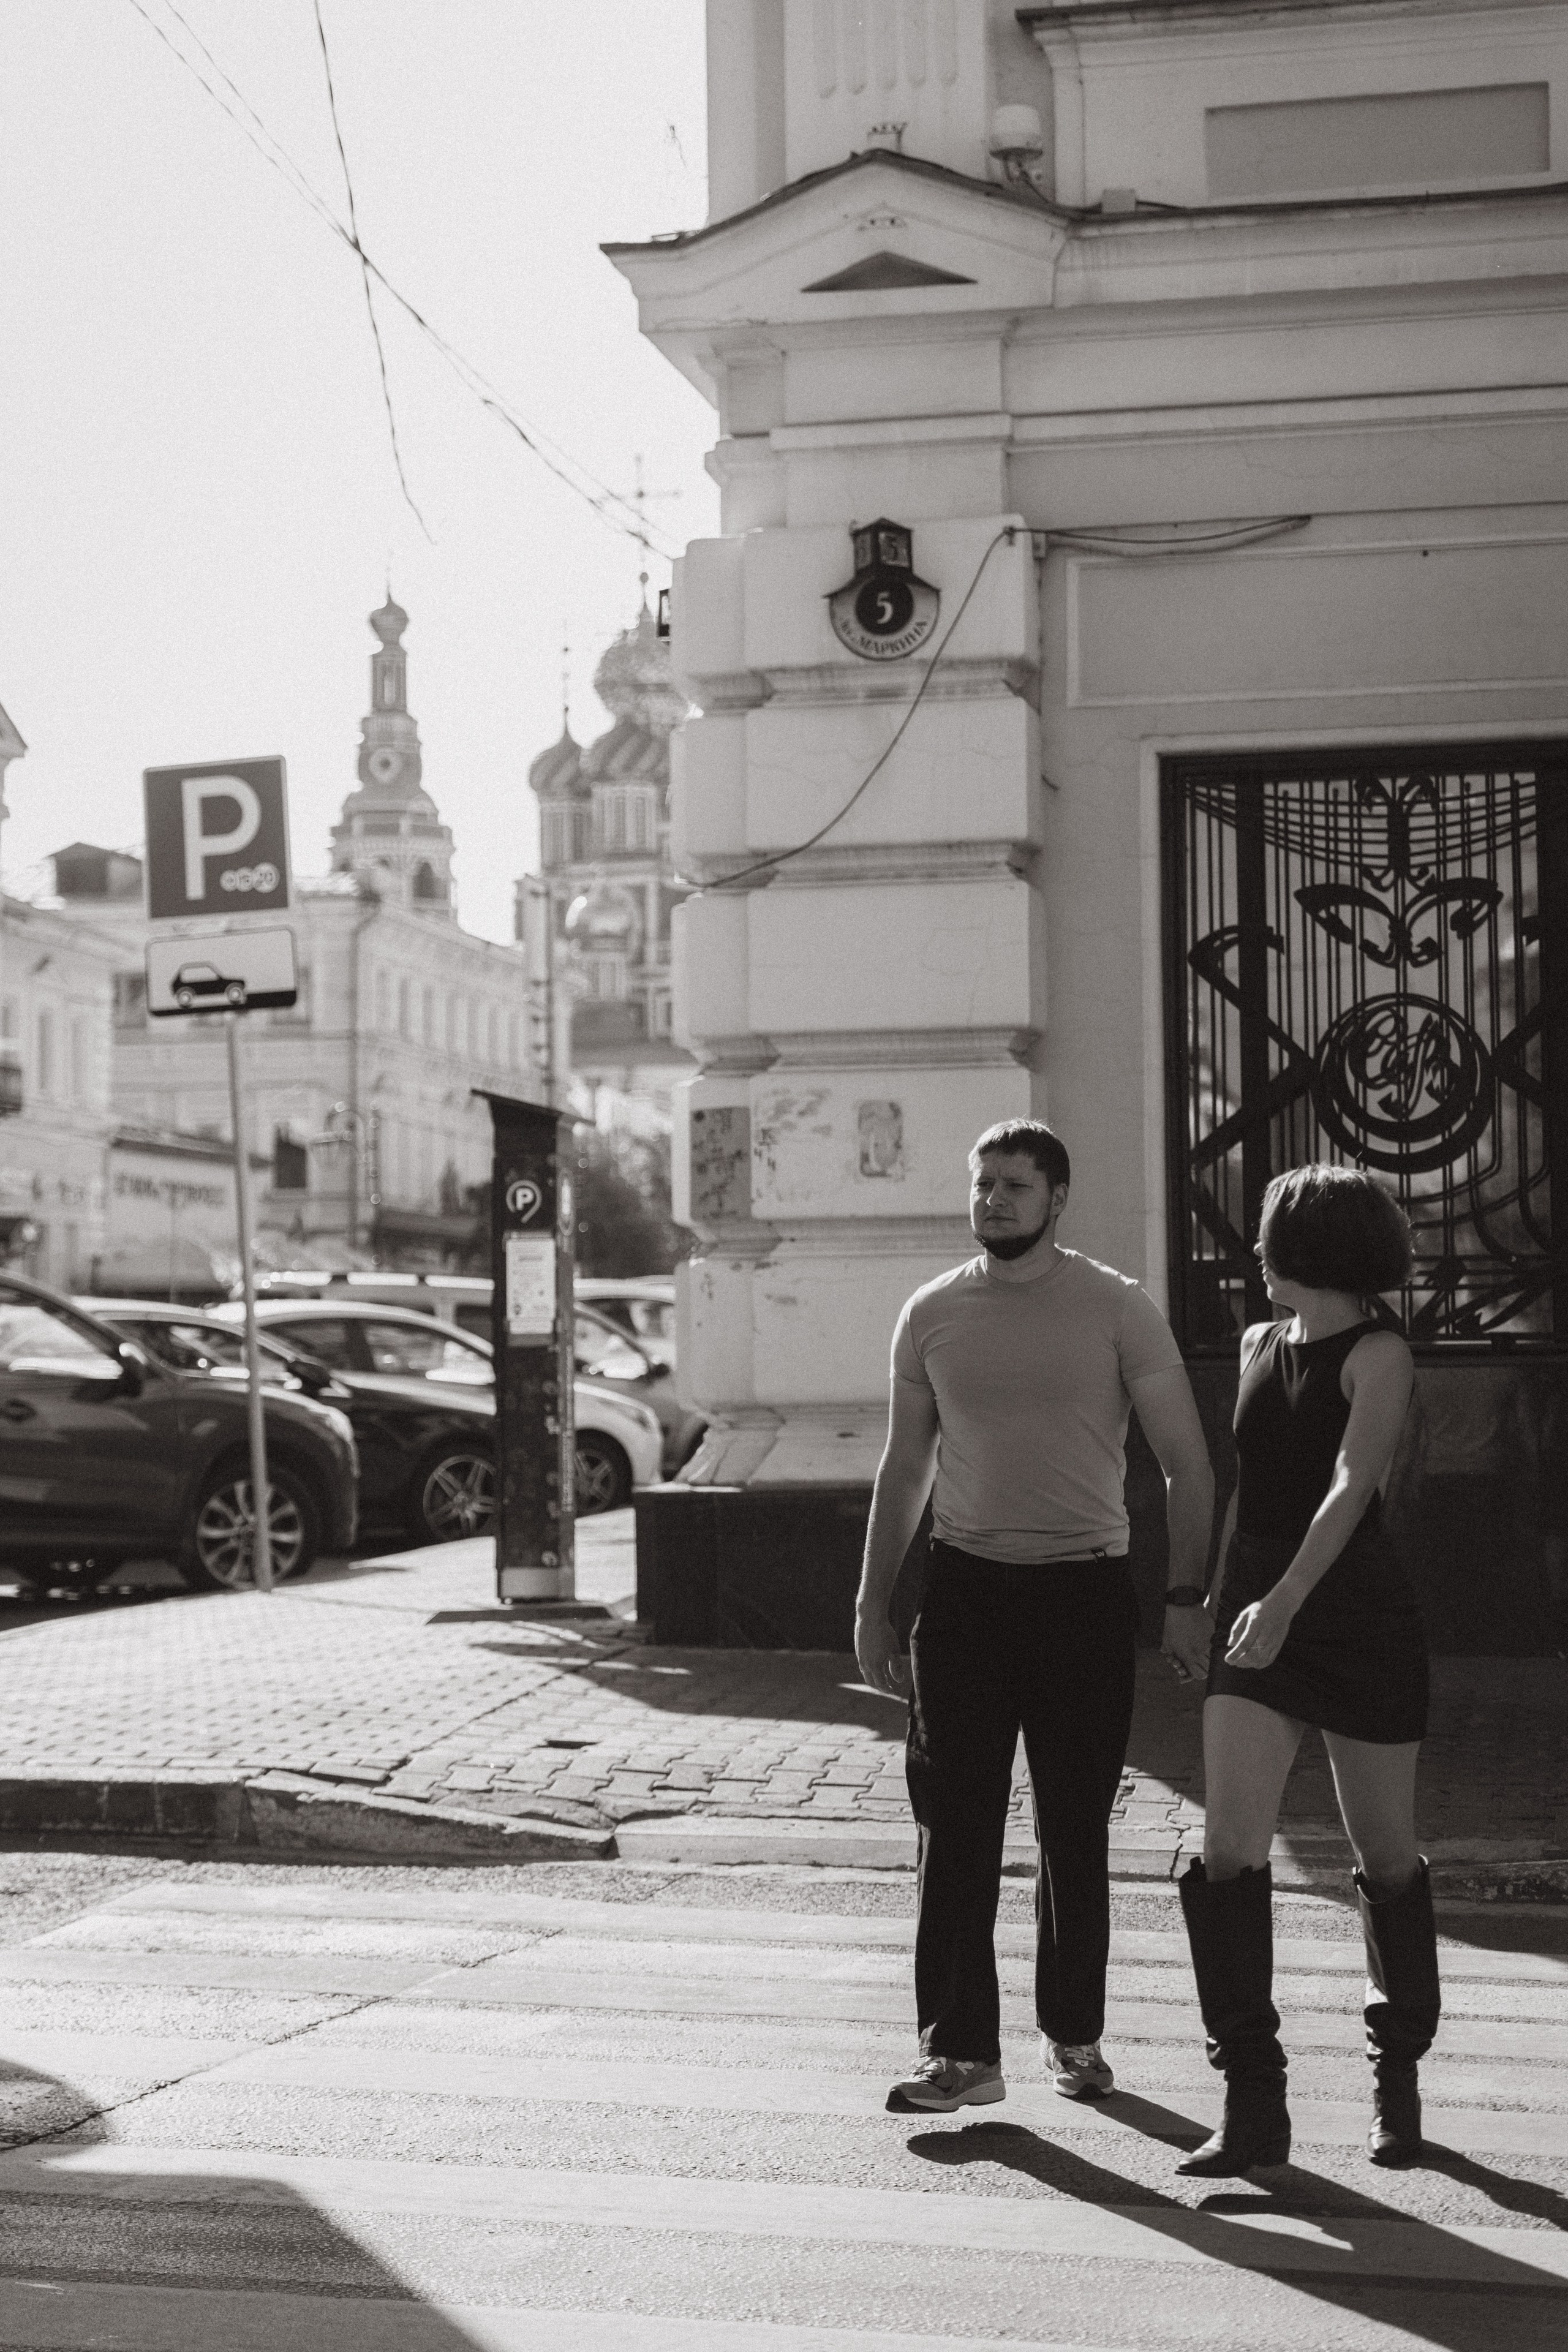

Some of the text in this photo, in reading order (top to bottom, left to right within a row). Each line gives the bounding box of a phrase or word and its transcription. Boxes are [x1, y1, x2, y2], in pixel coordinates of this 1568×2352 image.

[876, 592, 894, 624] 5
[181, 774, 262, 901] P
[516, 1187, 534, 1211] P
